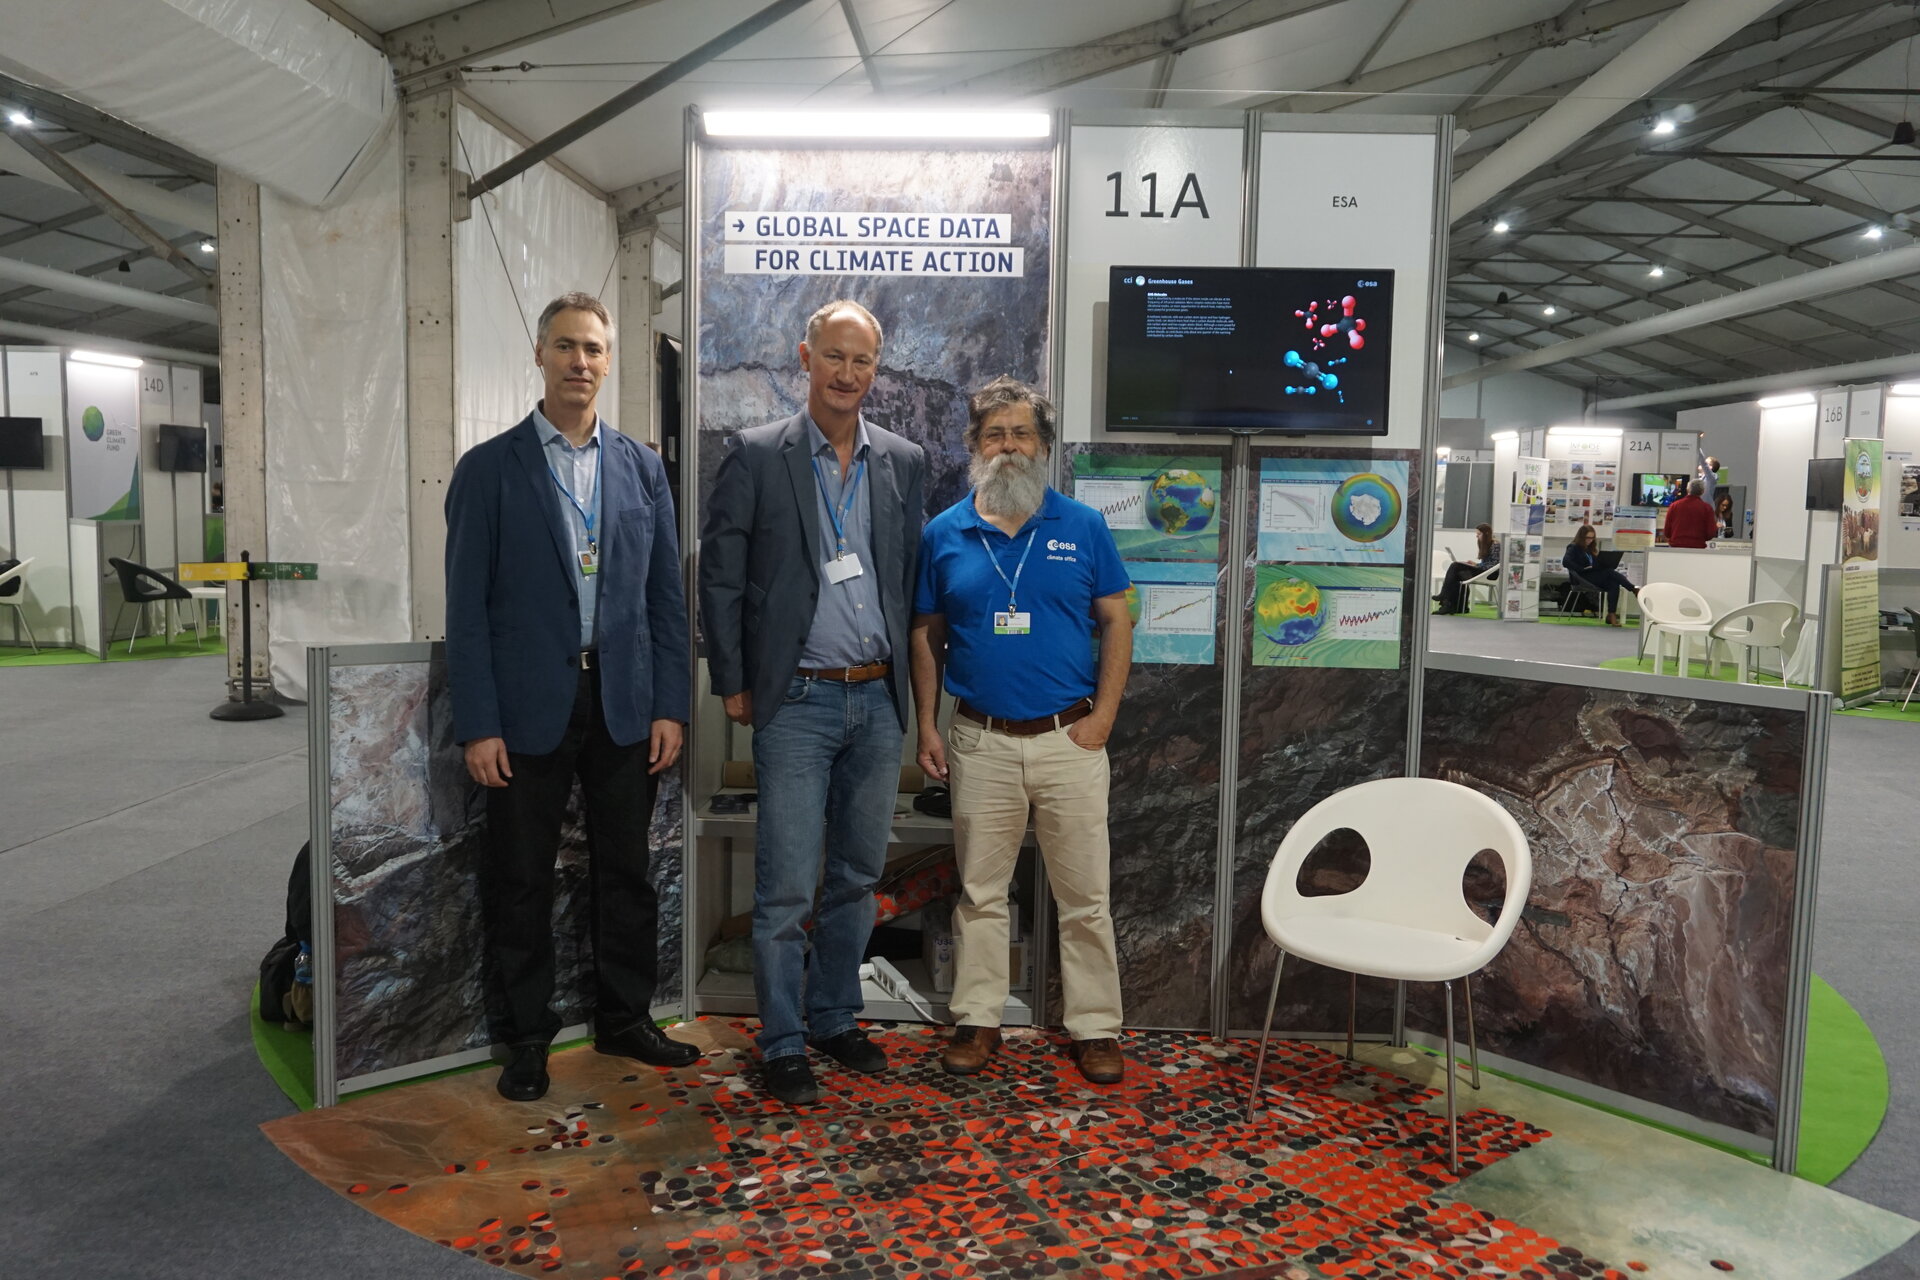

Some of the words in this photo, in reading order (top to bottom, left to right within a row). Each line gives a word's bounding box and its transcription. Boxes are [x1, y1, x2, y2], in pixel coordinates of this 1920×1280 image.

[1105, 171, 1210, 219] 11A
[1332, 196, 1358, 208] ESA
[756, 216, 848, 237] GLOBAL
[857, 217, 930, 238] SPACE
[940, 218, 1000, 239] DATA
[755, 249, 800, 270] FOR
[810, 250, 913, 271] CLIMATE
[922, 251, 1013, 273] ACTION
[144, 377, 164, 392] 14D
[1825, 406, 1843, 423] 16B
[106, 437, 126, 445] CLIMATE
[1630, 440, 1652, 452] 21A
